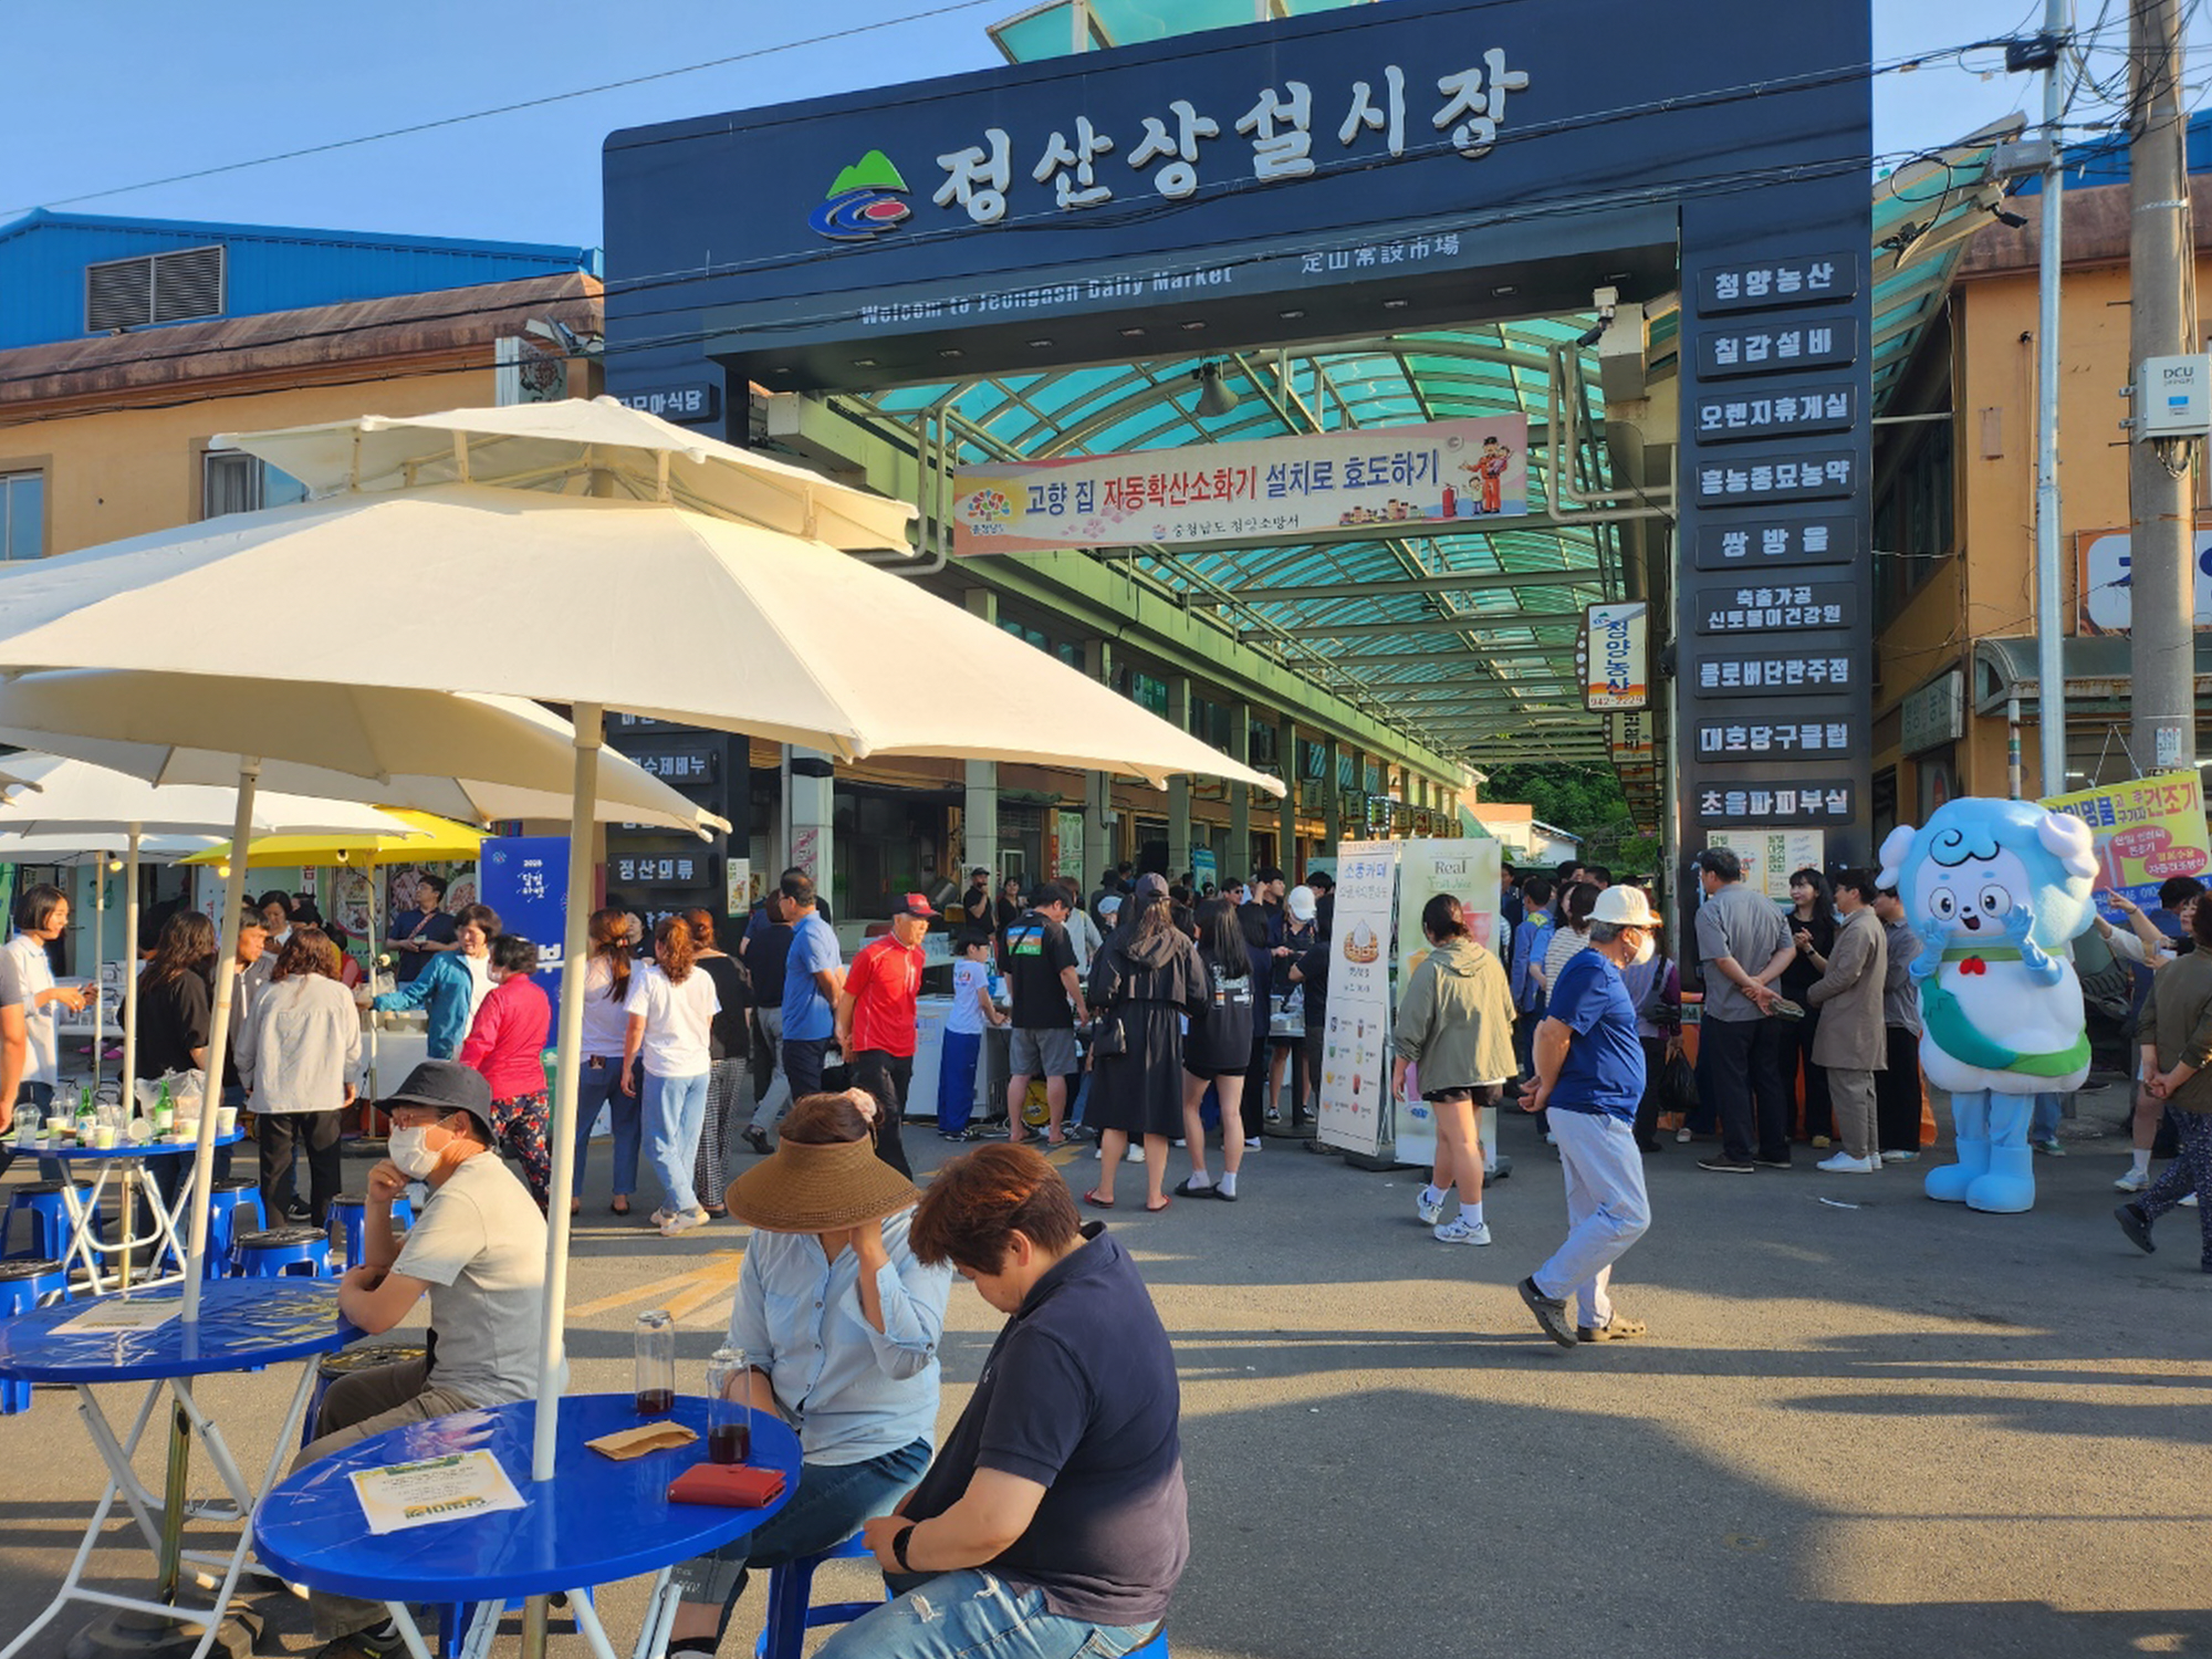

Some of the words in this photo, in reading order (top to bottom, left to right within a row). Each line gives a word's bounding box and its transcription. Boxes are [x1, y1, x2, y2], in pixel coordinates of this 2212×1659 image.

[933, 48, 1528, 224] 정산상설시장
[1088, 276, 1143, 300] Daily
[1153, 266, 1233, 292] Market
[1715, 262, 1834, 300] 청양농산
[1715, 328, 1832, 365] 칠갑설비
[2163, 366, 2194, 379] DCU
[1700, 393, 1847, 431] 오렌지휴게실
[1026, 483, 1067, 515] 고향
[1075, 480, 1095, 513] 집
[1103, 466, 1257, 510] 자동확산소화기
[1265, 461, 1333, 498] 설치로
[1343, 448, 1439, 489] 효도하기
[1702, 460, 1849, 495] 흥농종묘농약
[1708, 605, 1841, 629] 신토불이건강원
[1604, 620, 1631, 695] 청양농산
[1700, 658, 1849, 687] 클로버단란주점
[1700, 789, 1848, 816] 초음파피부실
[2145, 781, 2199, 817] 건조기
[619, 859, 694, 880] 정산의류
[1435, 860, 1466, 874] Real
